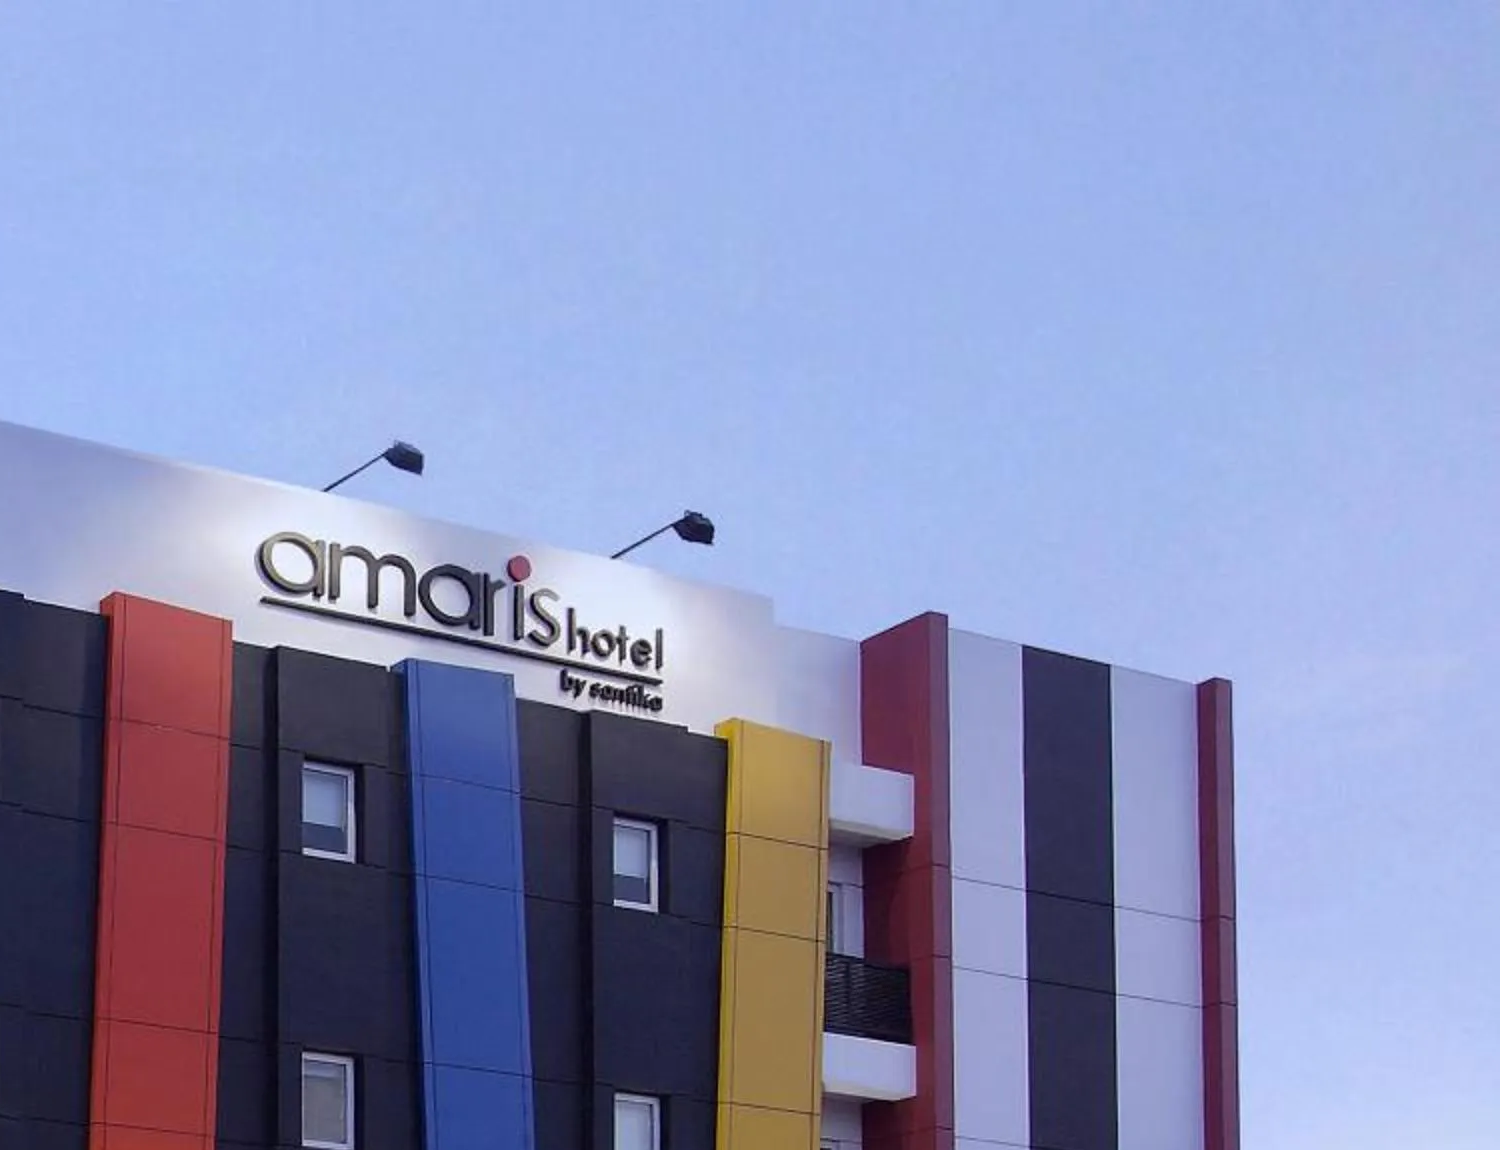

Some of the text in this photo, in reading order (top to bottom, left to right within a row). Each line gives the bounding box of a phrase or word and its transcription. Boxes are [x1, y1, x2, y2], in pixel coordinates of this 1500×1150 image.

[257, 531, 663, 670] amaris hotel
[560, 668, 587, 699] by
